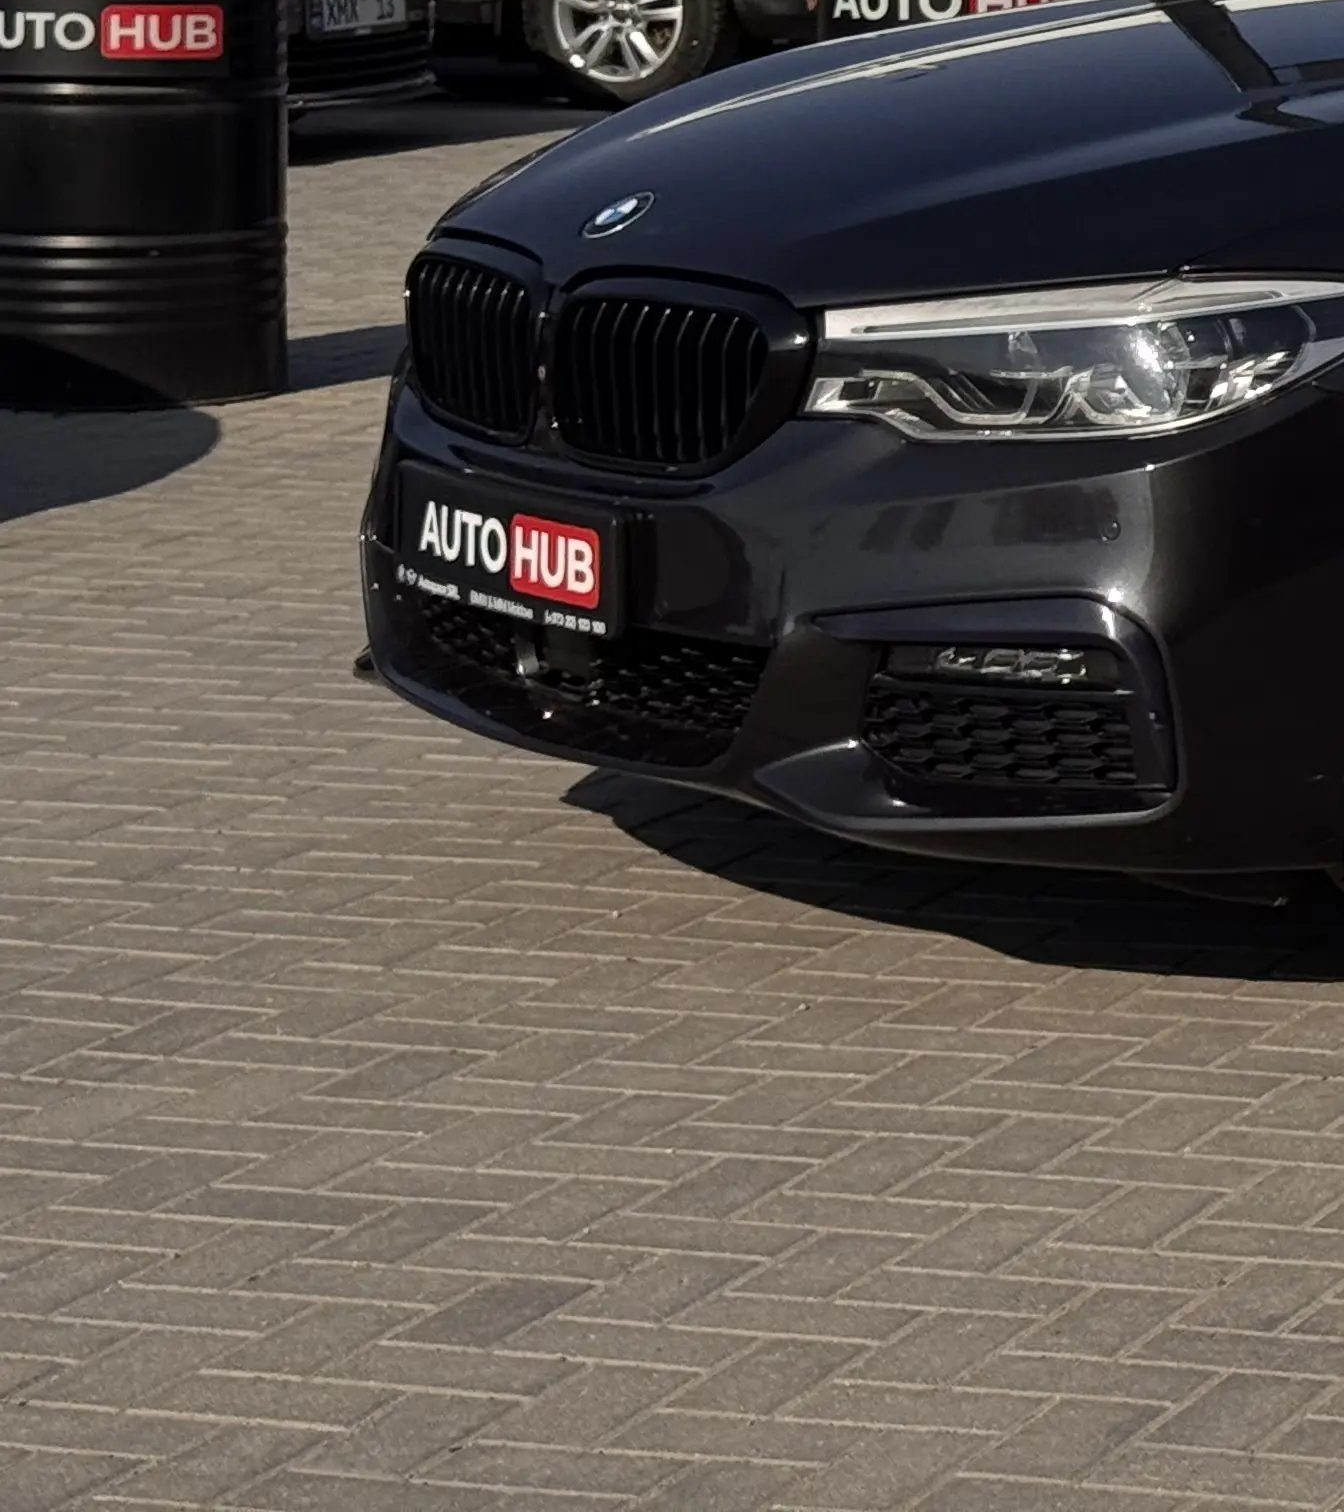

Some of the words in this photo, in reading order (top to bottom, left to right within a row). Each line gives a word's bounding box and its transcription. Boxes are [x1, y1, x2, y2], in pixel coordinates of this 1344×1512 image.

[0, 11, 96, 51] UTO
[109, 14, 218, 51] HUB
[418, 500, 508, 574] AUTO
[513, 526, 595, 595] HUB
